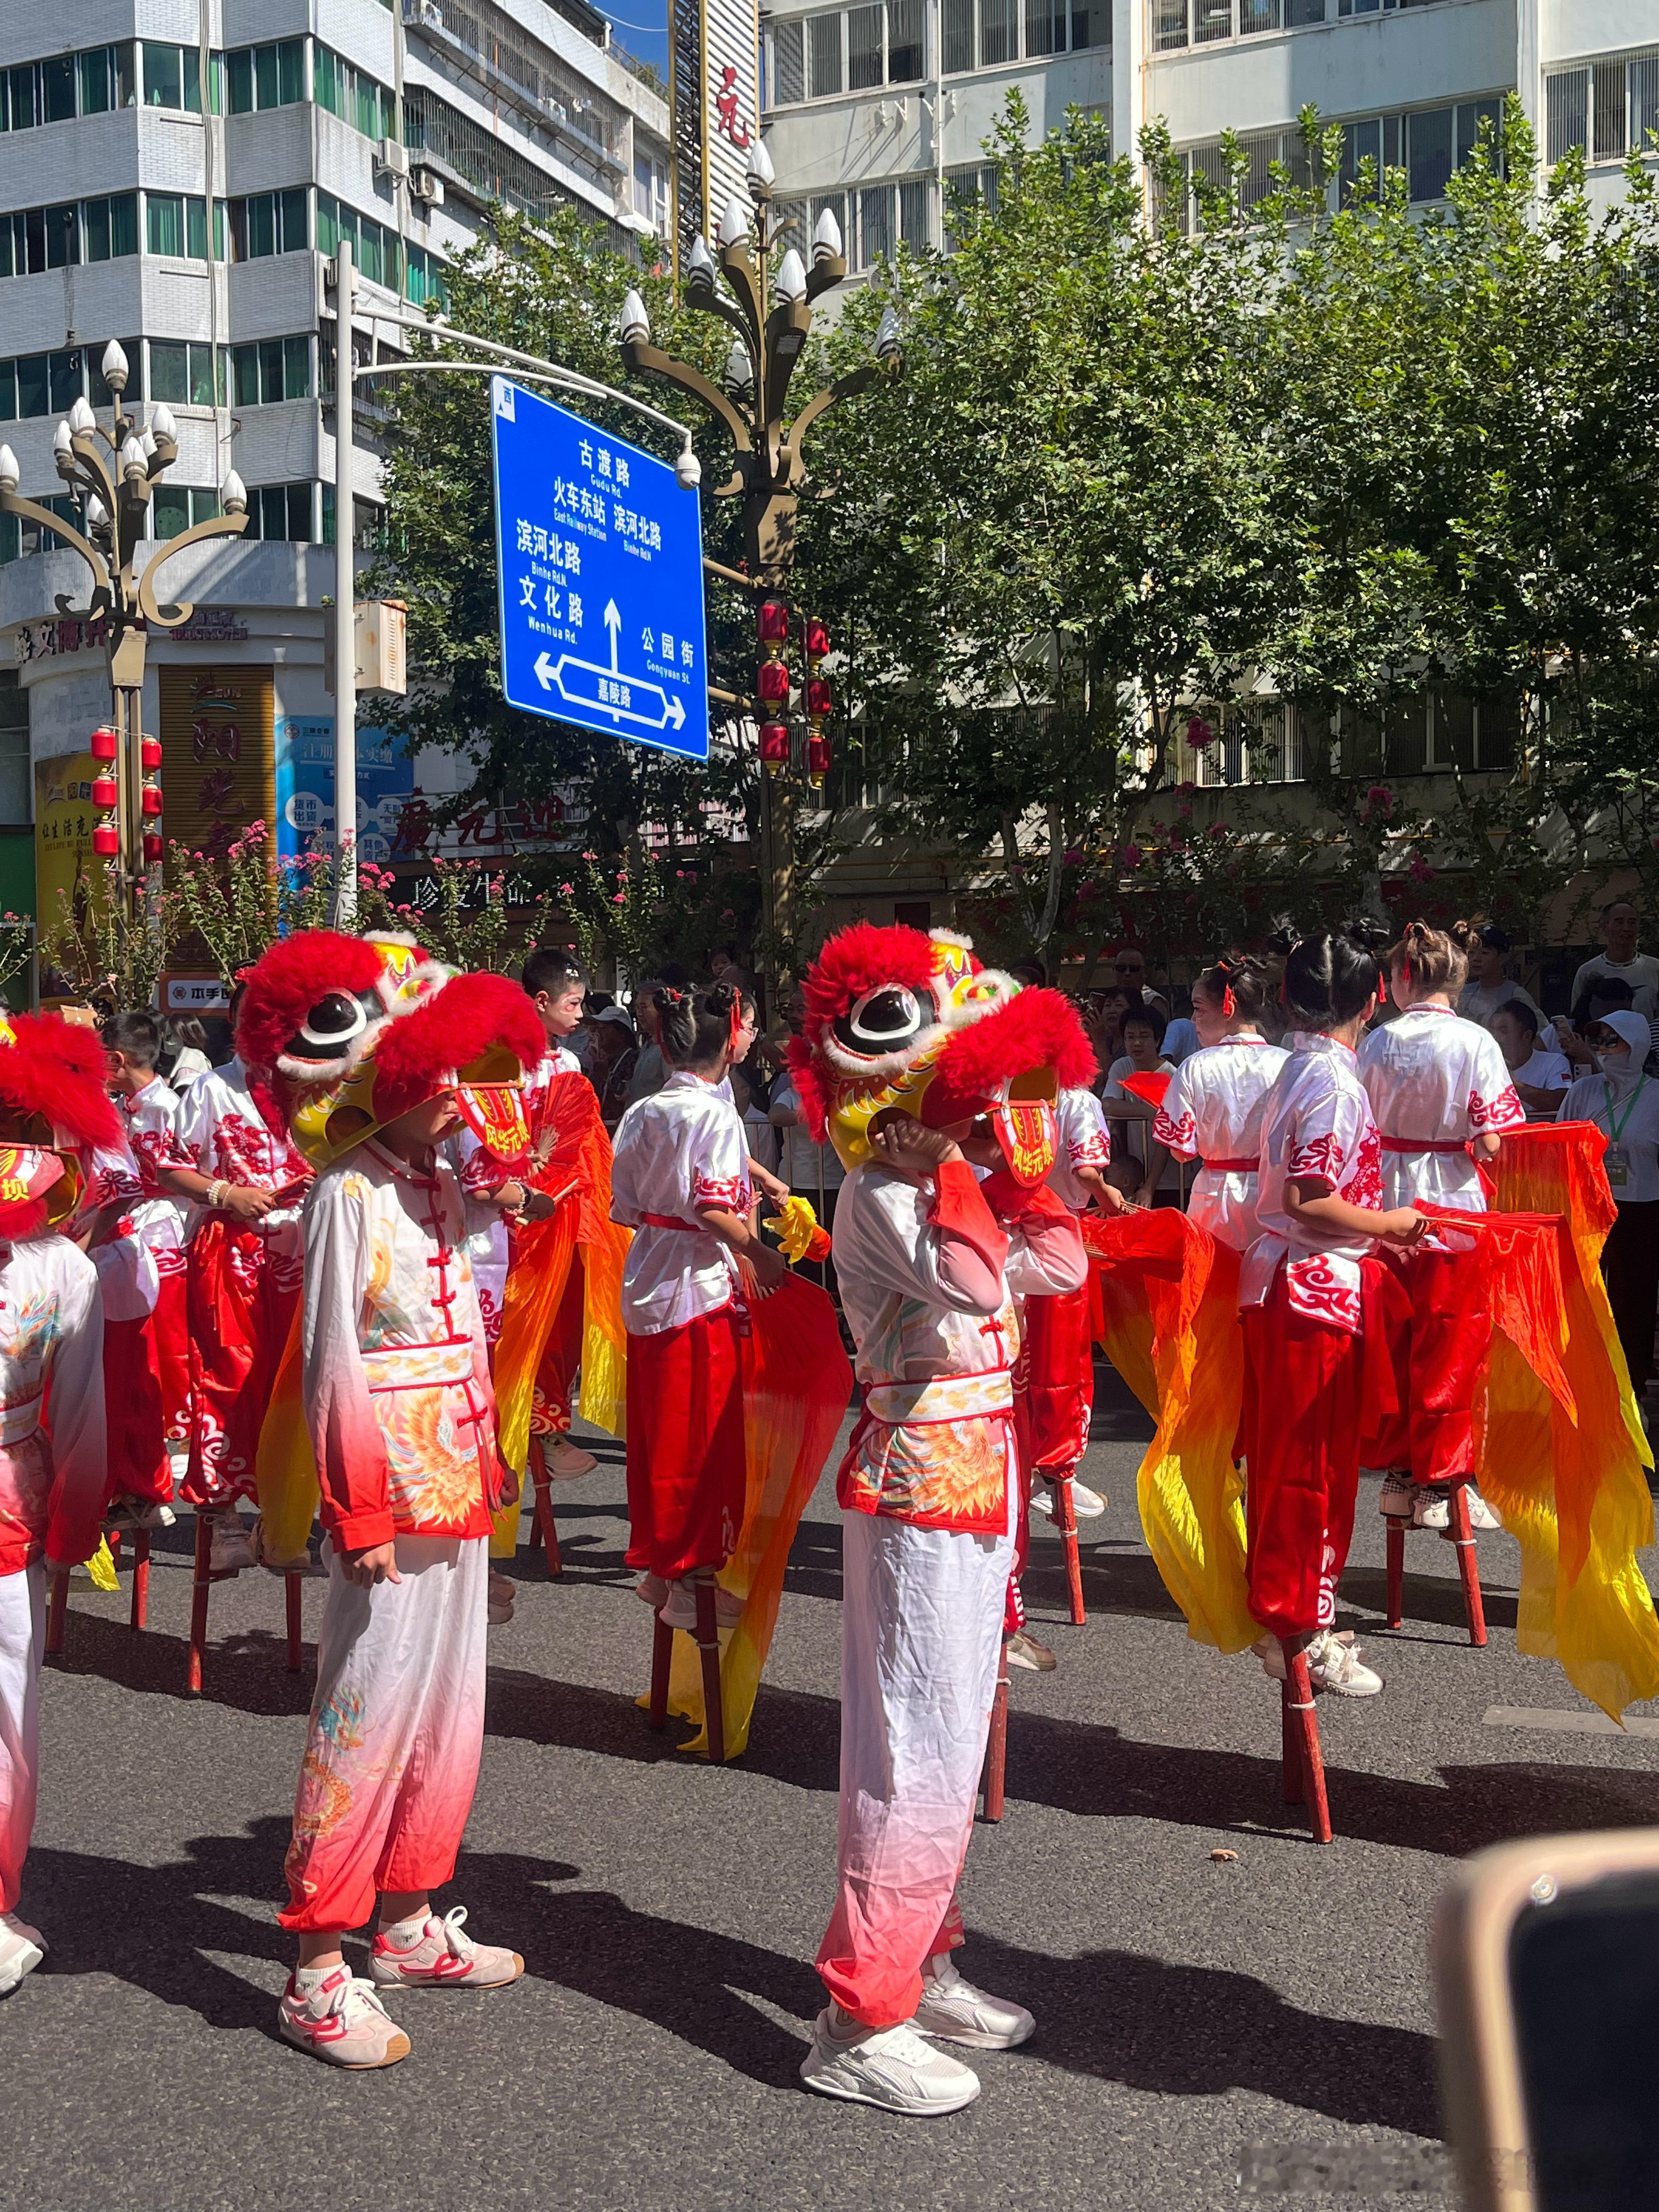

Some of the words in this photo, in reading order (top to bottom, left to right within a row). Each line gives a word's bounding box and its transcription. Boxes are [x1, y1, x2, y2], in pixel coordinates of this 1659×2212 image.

[578, 439, 630, 488] 古渡路
[554, 476, 606, 526] 火车东站
[591, 474, 610, 493] Gudu
[611, 483, 623, 499] Rd.
[554, 507, 566, 524] East
[588, 523, 607, 542] Station
[613, 503, 661, 551] 滨河北路
[516, 518, 581, 575] 滨河北路
[531, 561, 551, 581] Binhe
[519, 575, 583, 628] 文化路
[528, 615, 563, 640] Wenhua
[565, 628, 578, 645] Rd.
[641, 627, 693, 668] 公园街
[646, 659, 680, 681] Gongyuan
[681, 672, 691, 685] St.
[597, 678, 631, 709] 嘉陵路
[295, 799, 317, 810] 货币
[295, 811, 317, 822] 出资
[364, 839, 383, 850] 其他
[484, 1119, 531, 1155] 风华元坝
[1013, 1139, 1054, 1177] 风华元坝
[1, 1177, 30, 1201] 坝
